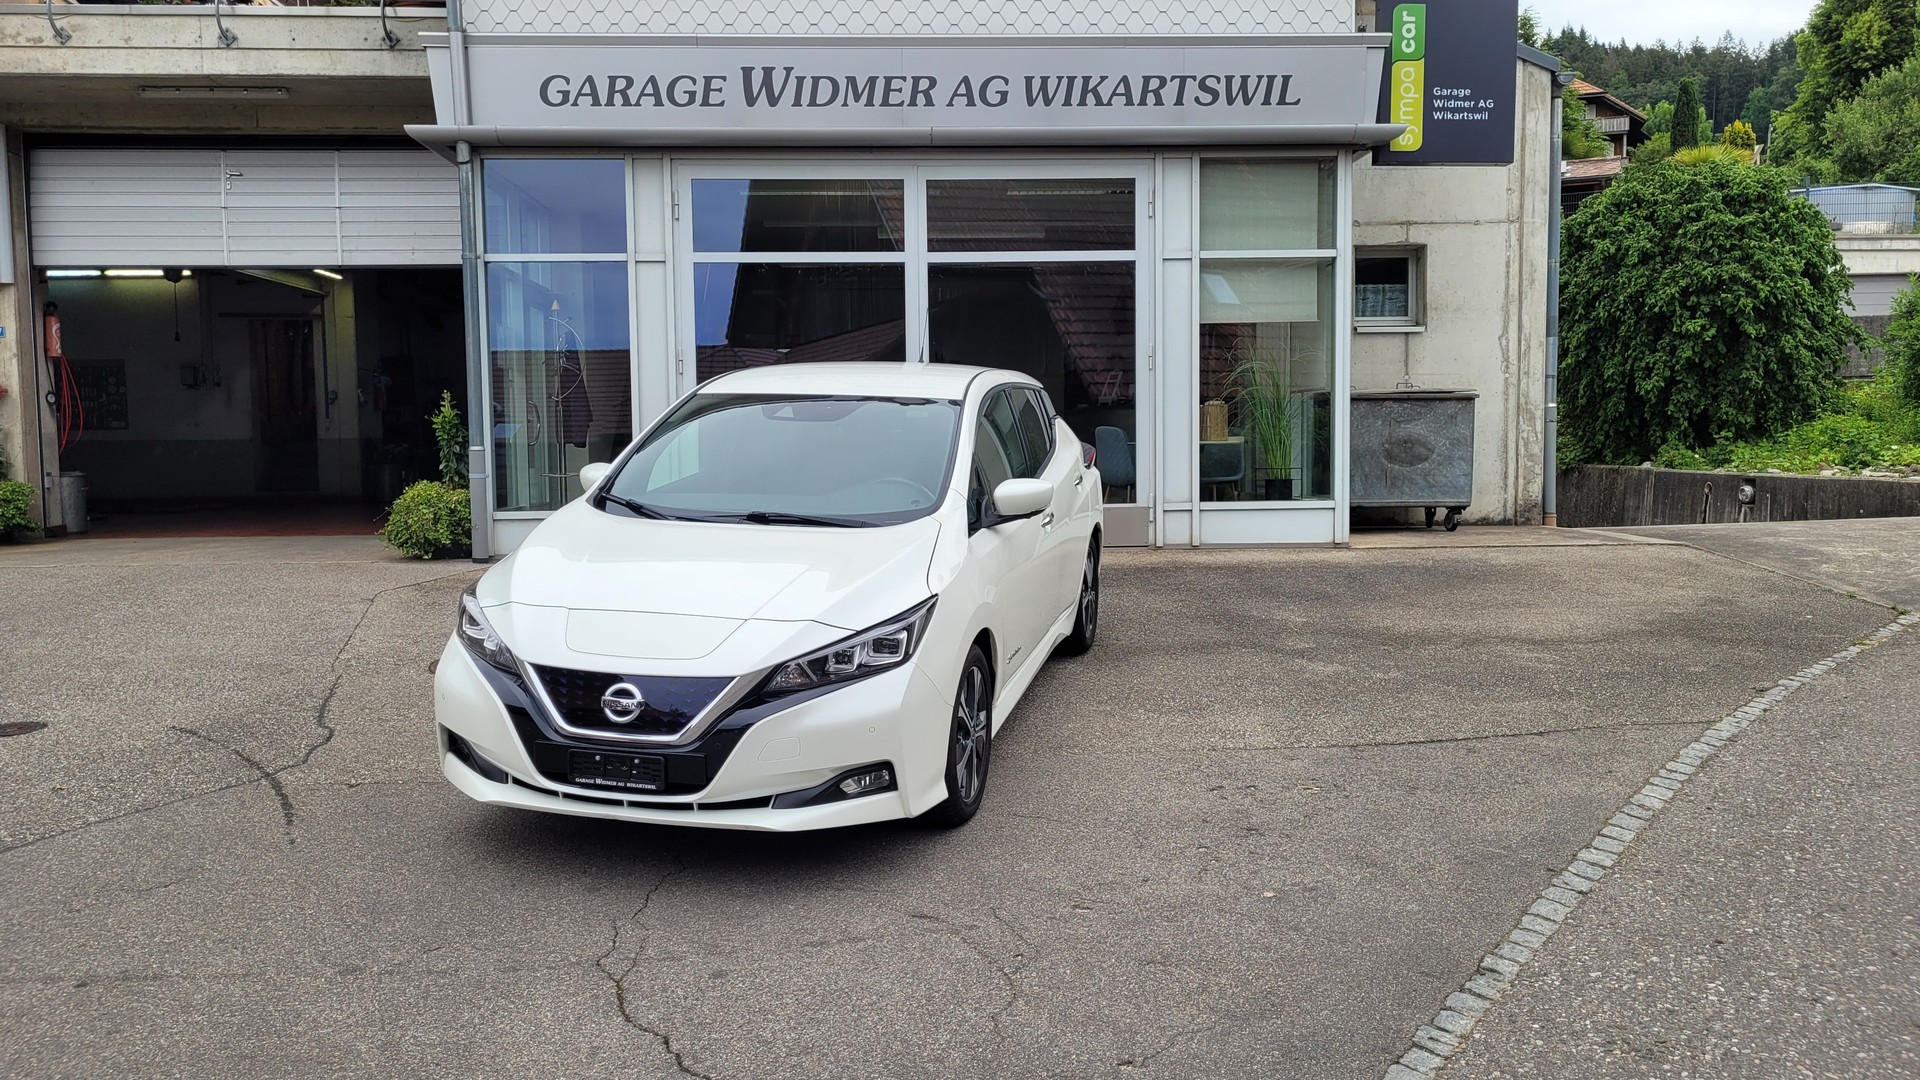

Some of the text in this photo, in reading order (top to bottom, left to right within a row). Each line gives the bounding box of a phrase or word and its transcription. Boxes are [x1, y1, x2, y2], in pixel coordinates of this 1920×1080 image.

[1400, 11, 1419, 145] sympa car
[539, 66, 1301, 108] GARAGE WIDMER AG WIKARTSWIL
[1433, 87, 1471, 97] Garage
[1433, 99, 1494, 108] Widmer AG
[1433, 111, 1488, 120] Wikartswil
[603, 699, 637, 709] NISSAN
[626, 782, 657, 790] WIKARTSWIL
